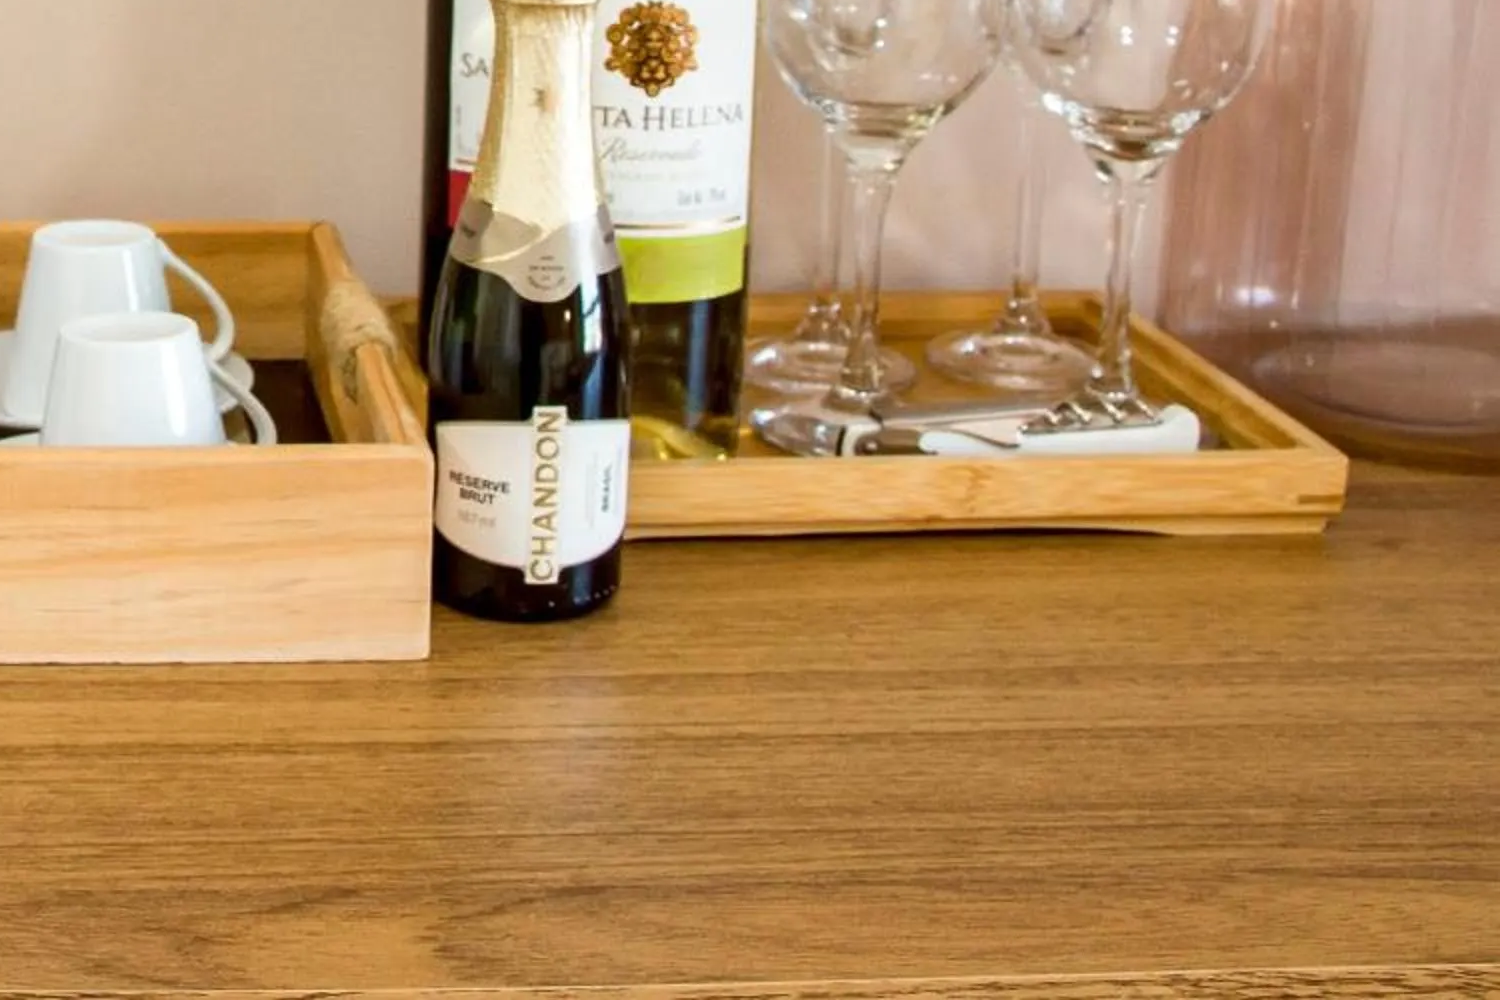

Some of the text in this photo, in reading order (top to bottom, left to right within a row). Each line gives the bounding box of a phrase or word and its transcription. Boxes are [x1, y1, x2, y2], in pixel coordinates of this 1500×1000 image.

[459, 52, 489, 78] SA
[592, 103, 744, 132] TA HELENA
[459, 487, 496, 505] BRUT
[530, 411, 561, 581] CHANDON
